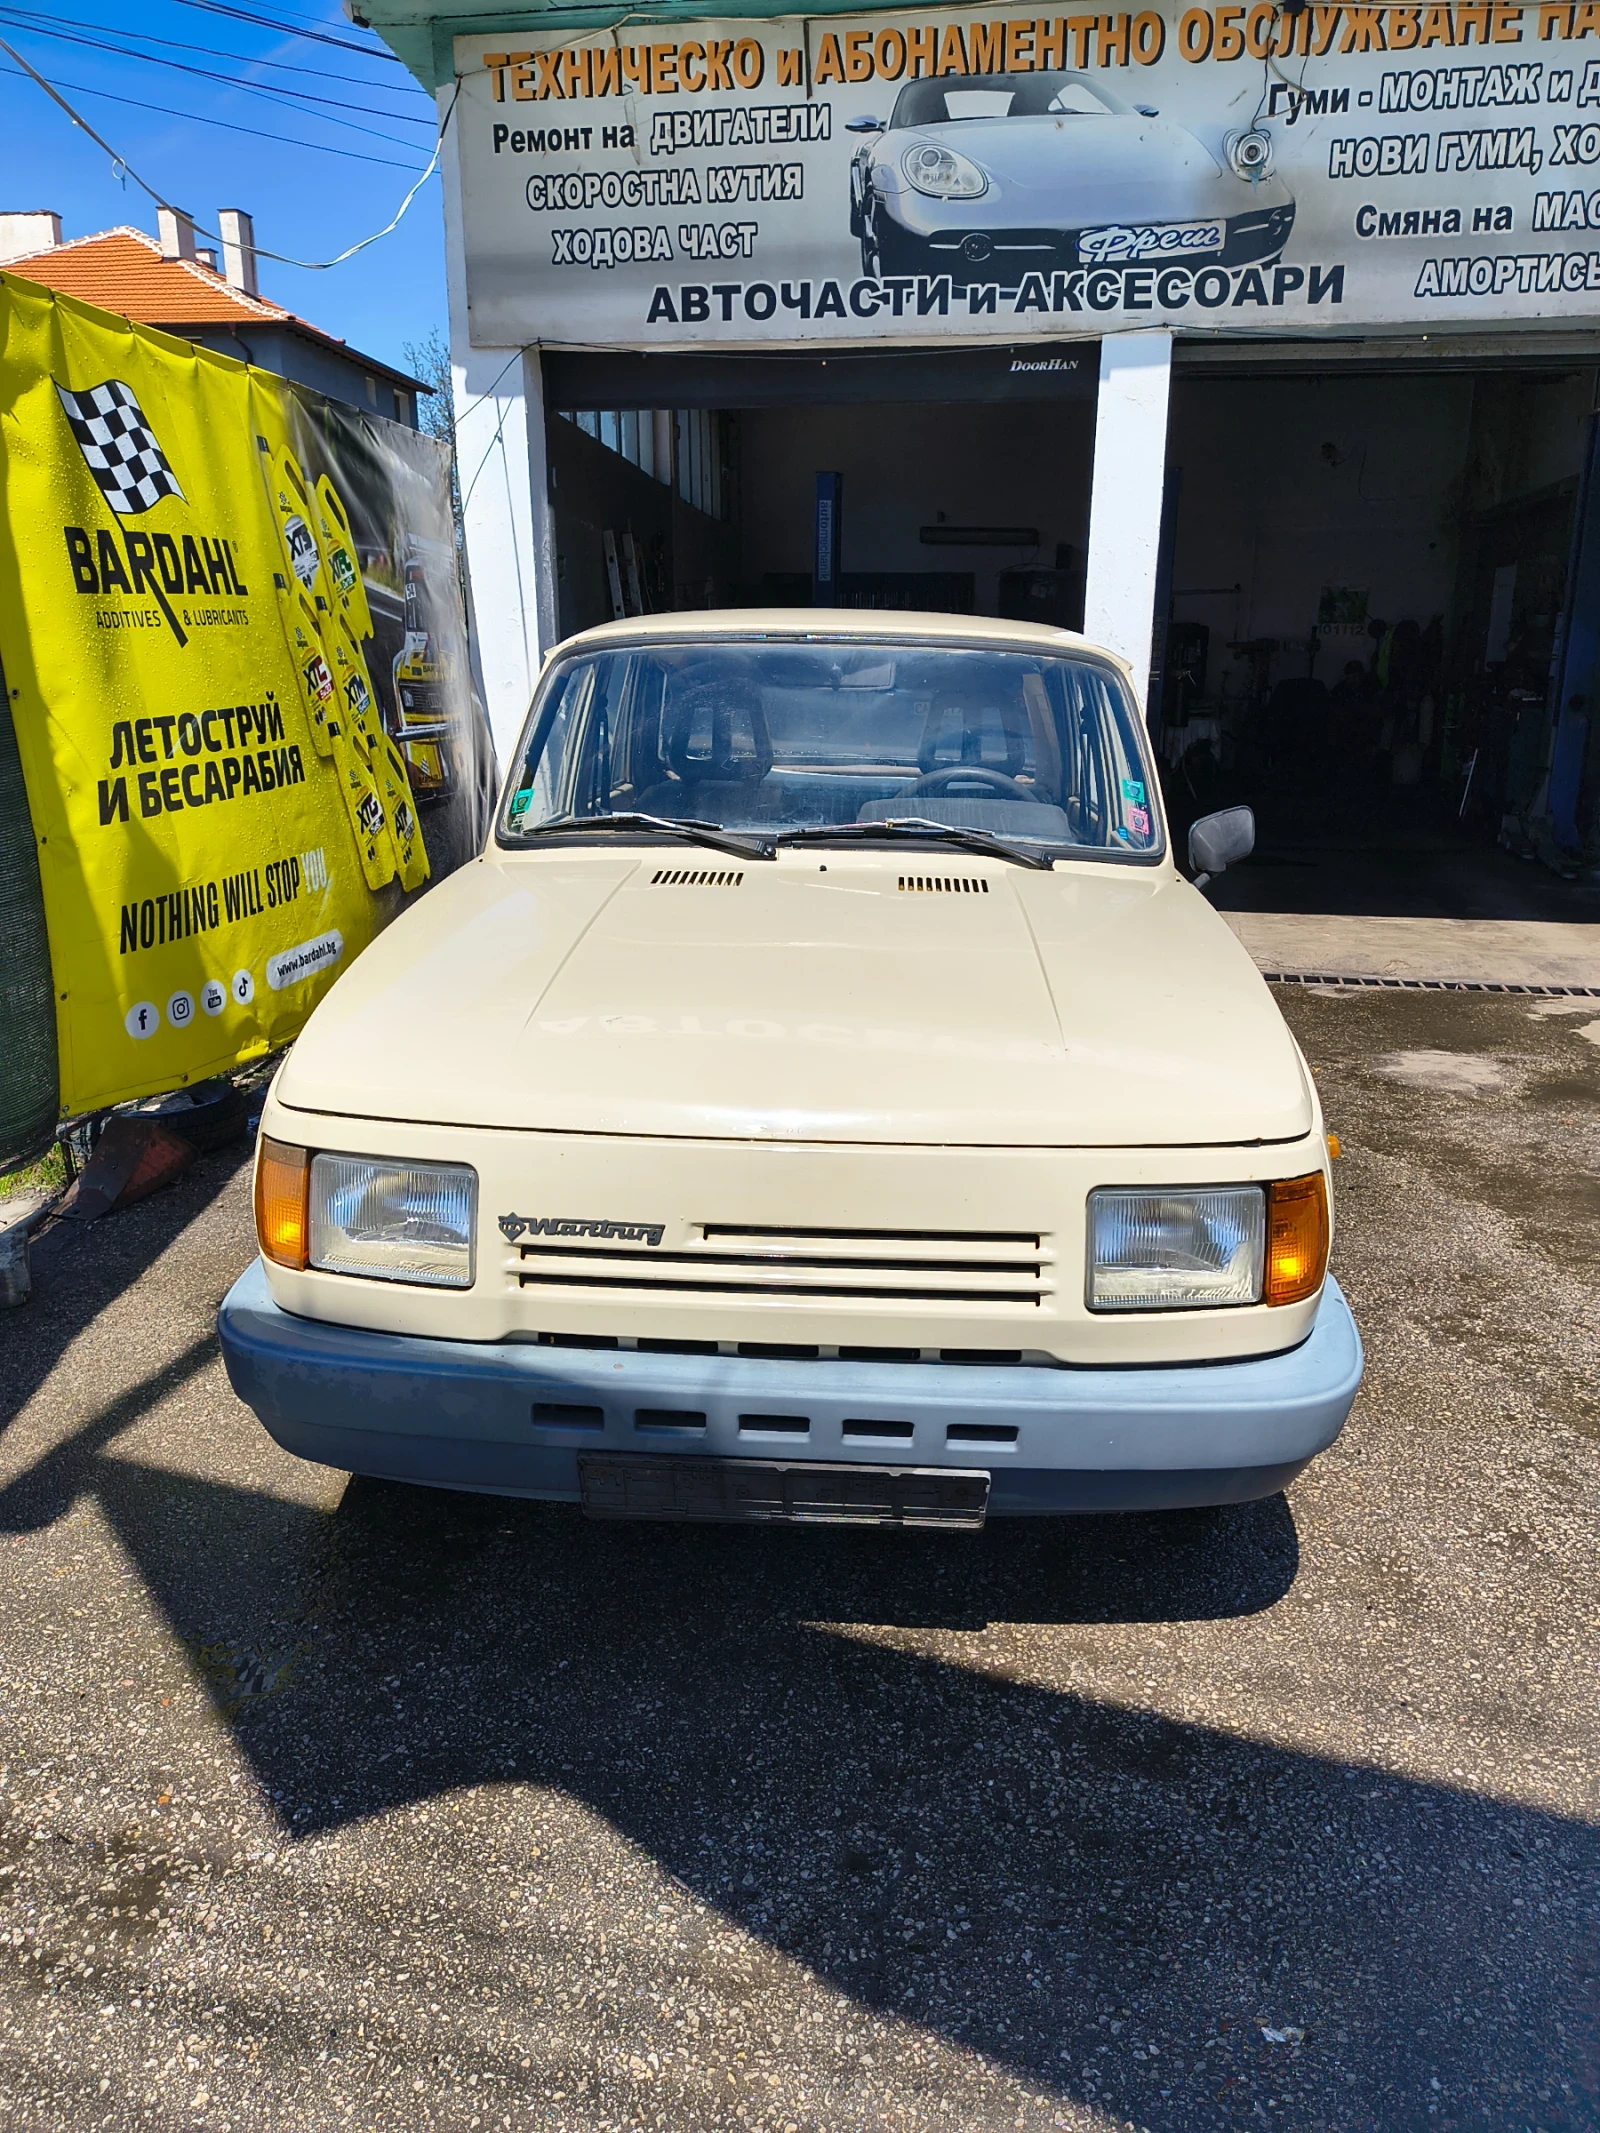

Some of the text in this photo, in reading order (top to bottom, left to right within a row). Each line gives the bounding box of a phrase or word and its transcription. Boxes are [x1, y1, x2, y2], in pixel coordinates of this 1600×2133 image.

[484, 37, 764, 102] ТЕХНИЧЕСКО
[776, 47, 803, 87] и
[814, 10, 1165, 85] АБОНАМЕНТНО
[1178, 2, 1524, 63] ОБСЛУЖВАНЕ
[1268, 83, 1350, 126] Гуми
[1379, 62, 1544, 114] МОНТАЖ
[1547, 69, 1574, 103] и
[493, 103, 832, 156] Ремонт на ДВИГАТЕЛИ
[1329, 133, 1430, 179] НОВИ
[1436, 126, 1544, 176] ГУМИ,
[526, 162, 804, 211] СКОРОСТНА КУТИЯ
[551, 222, 758, 269] ХОДОВА ЧАСТ
[1356, 204, 1462, 238] Смяна
[1472, 204, 1514, 232] на
[645, 265, 1346, 324] АВТОЧАСТИ и АКСЕСОАРИ
[64, 526, 249, 597] BARDAHL
[97, 610, 162, 629] ADDITIVES
[193, 609, 249, 627] LUBRICANTS
[110, 691, 286, 769] ЛЕТОСТРУЙ
[98, 745, 306, 826] И БЕСАРАБИЯ
[120, 847, 328, 955] NOTHING WILL STOP YOU
[277, 940, 337, 978] www.bardahl.bg
